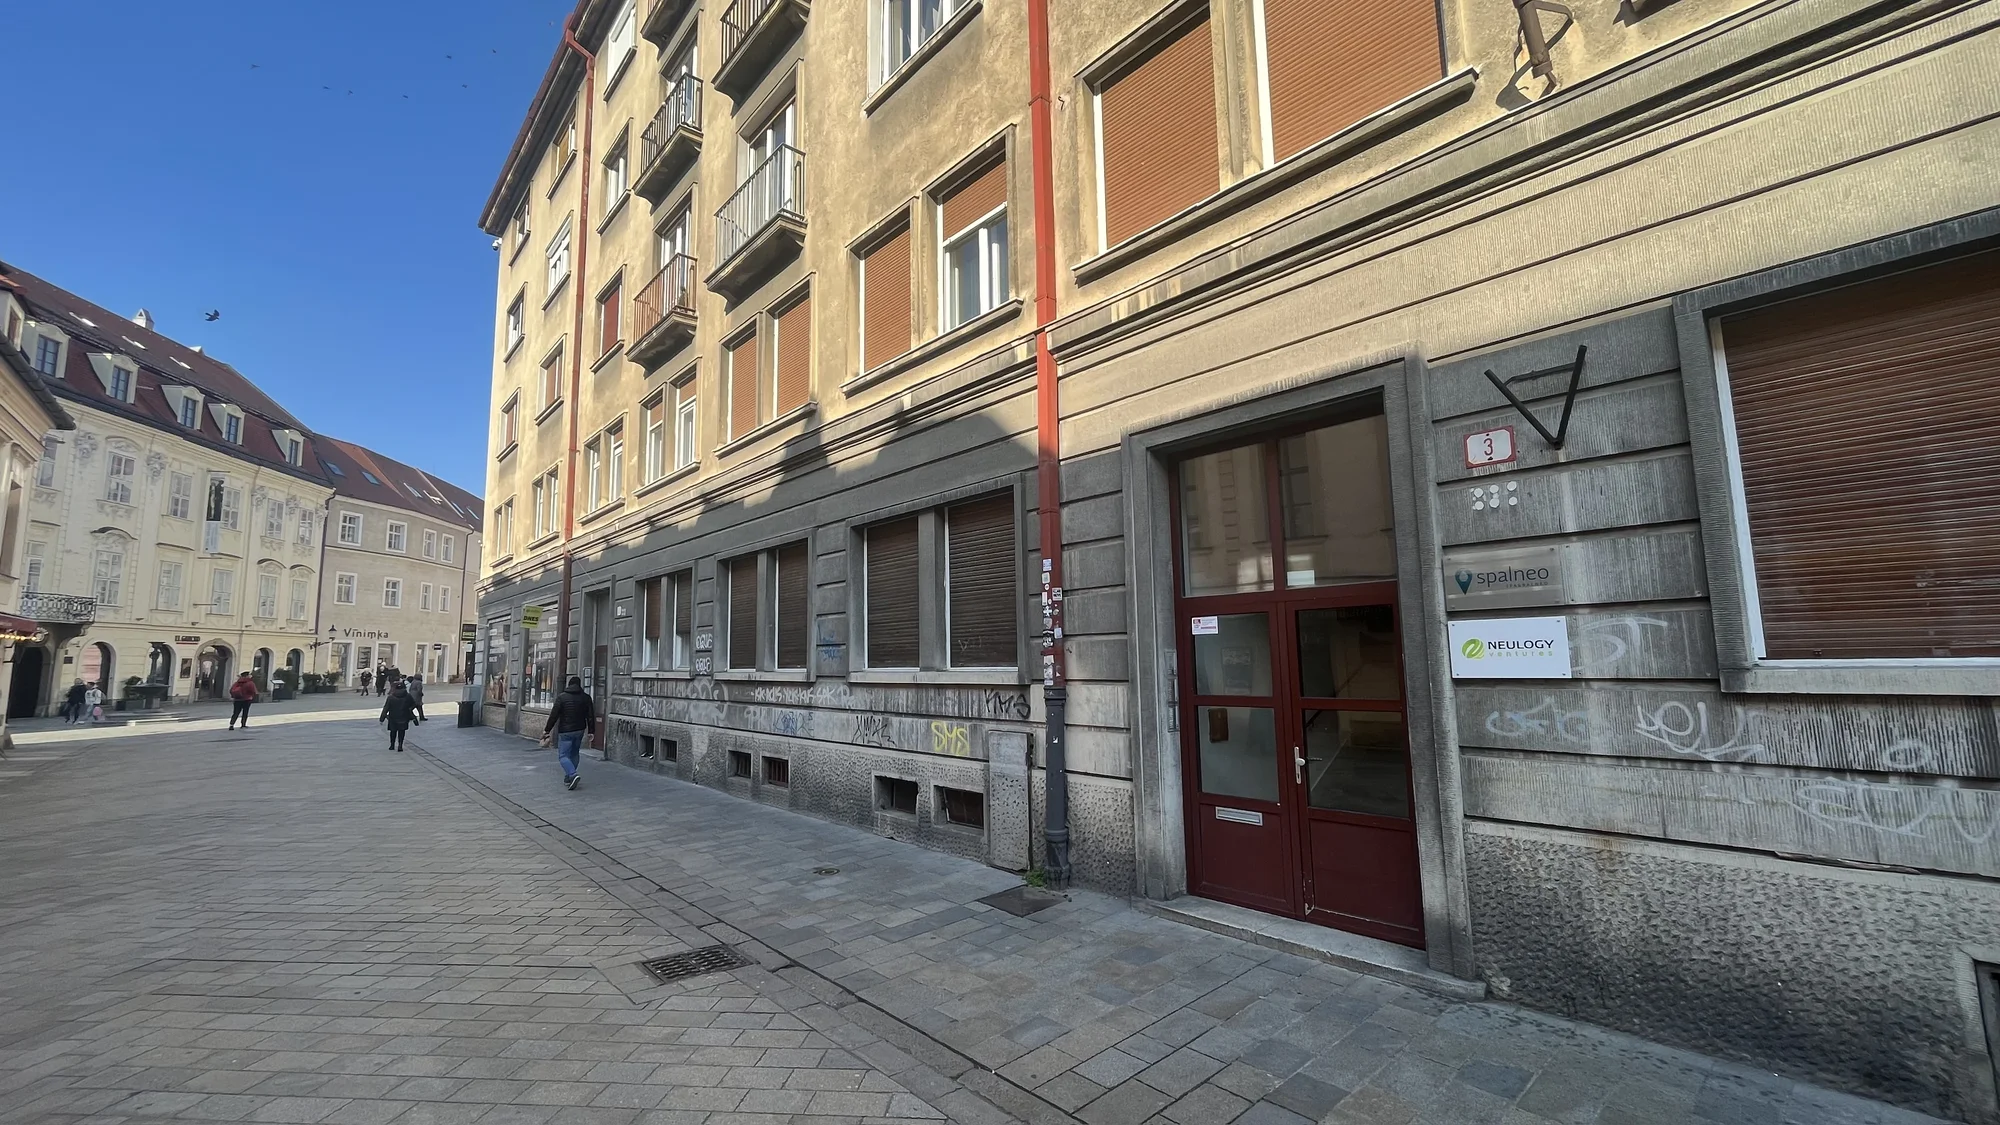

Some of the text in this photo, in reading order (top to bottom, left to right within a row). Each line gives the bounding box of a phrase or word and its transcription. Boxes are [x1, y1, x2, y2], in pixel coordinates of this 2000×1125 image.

[1483, 437, 1495, 456] 3
[1477, 565, 1549, 587] spalneo
[1487, 639, 1554, 650] NEULOGY
[1489, 650, 1554, 658] ventures
[930, 720, 971, 757] SMS
